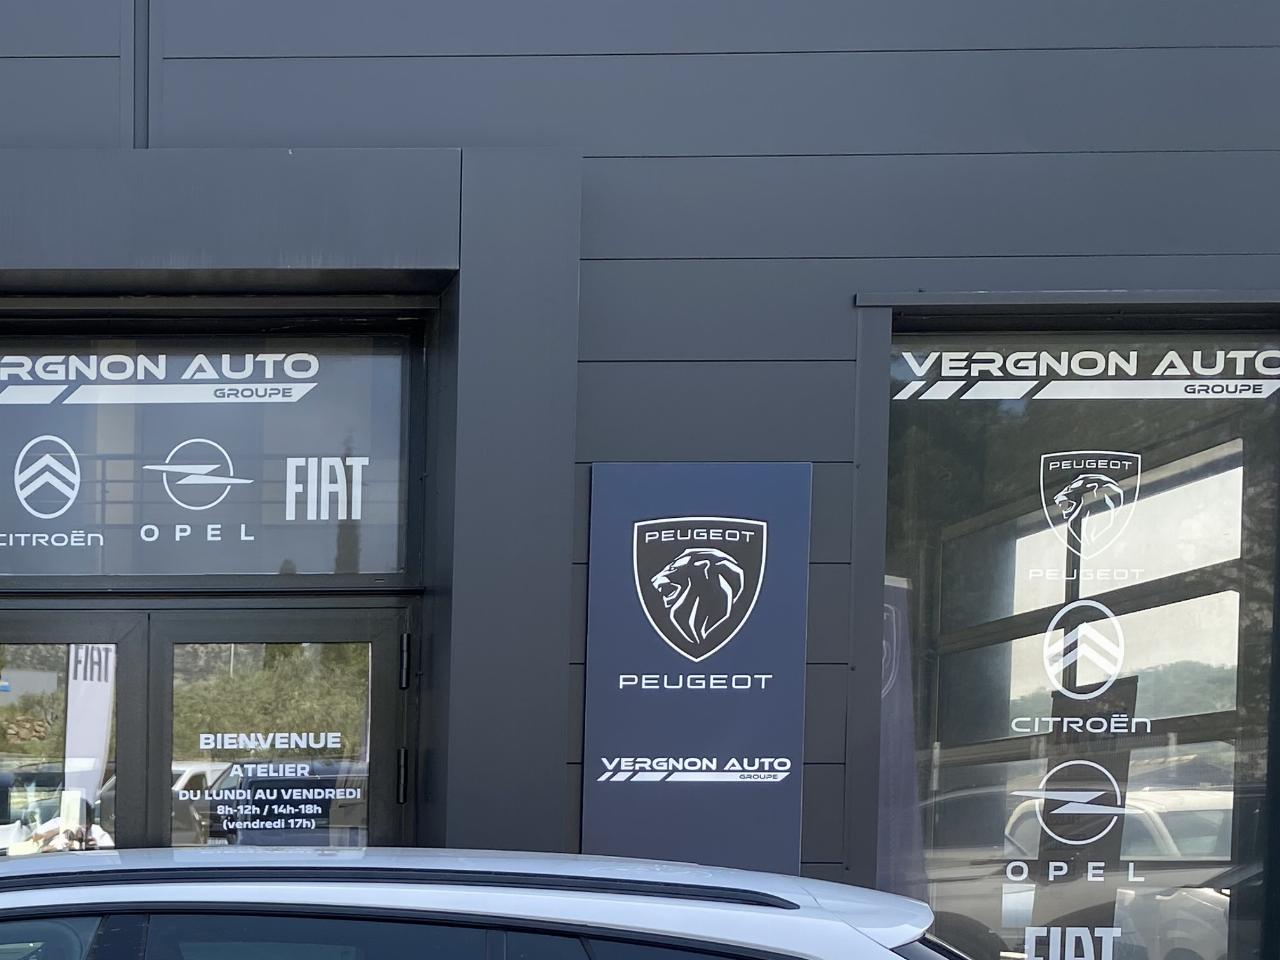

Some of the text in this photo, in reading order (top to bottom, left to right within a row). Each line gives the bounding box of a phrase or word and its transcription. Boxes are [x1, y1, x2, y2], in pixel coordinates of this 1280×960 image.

[182, 352, 320, 380] AUTO
[901, 350, 1280, 377] VERGNON AUTO
[213, 387, 294, 399] GROUPE
[1183, 383, 1264, 395] GROUPE
[1049, 459, 1133, 472] PEUGEOT
[286, 456, 370, 521] FIAT
[140, 524, 256, 542] OPEL
[645, 529, 755, 543] PEUGEOT
[1027, 567, 1145, 581] PEUGEOT
[73, 645, 112, 683] FIAT
[619, 674, 773, 690] PEUGEOT
[1010, 714, 1152, 733] CITROËN
[199, 732, 342, 749] BIENVENUE
[229, 764, 310, 777] ATELIER
[600, 757, 792, 771] VERGNON AUTO
[178, 788, 361, 801] DU LUNDI AU VENDREDI
[216, 804, 322, 816] 8h-12h / 14h-18h
[222, 818, 316, 831] (vendredi 17h)
[1005, 861, 1145, 882] OPEL
